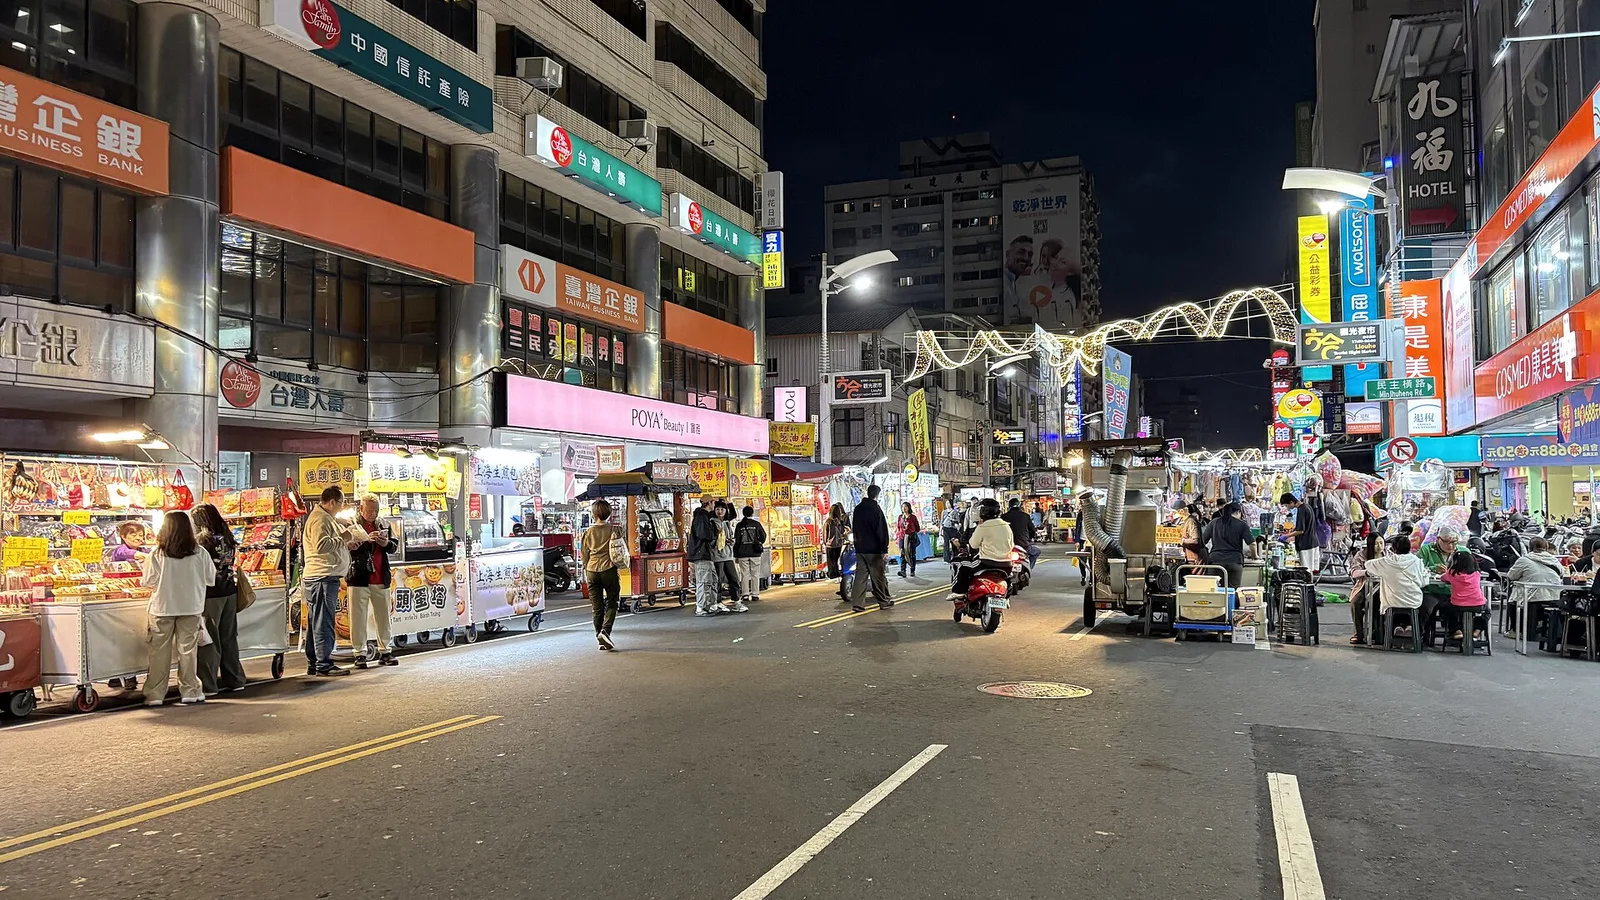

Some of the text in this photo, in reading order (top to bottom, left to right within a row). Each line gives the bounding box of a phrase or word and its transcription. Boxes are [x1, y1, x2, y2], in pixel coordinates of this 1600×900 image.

[302, 10, 341, 40] Family
[351, 32, 470, 108] 中國信託產險
[0, 122, 84, 158] USINESS
[1407, 79, 1458, 176] 九福
[98, 153, 144, 176] BANK
[578, 149, 626, 189] 台灣人壽
[1012, 195, 1068, 213] 乾淨世界
[1408, 181, 1457, 198] HOTEL
[1503, 187, 1528, 230] COSMED
[705, 217, 739, 247] 台灣人壽
[1351, 210, 1364, 276] watsons
[1309, 253, 1321, 297] 公益彩券
[564, 273, 639, 317] 臺灣企銀
[565, 298, 639, 325] TAIWAN BUSINESS BANK
[1401, 294, 1431, 379] 康是美
[222, 377, 260, 398] Family
[1376, 378, 1426, 390] 民主橫路
[1495, 355, 1531, 400] COSMED
[270, 384, 345, 412] 台灣人壽
[663, 418, 685, 436] Beauty
[474, 464, 518, 480] 上海生煎包
[476, 565, 520, 583] 上海生煎包
